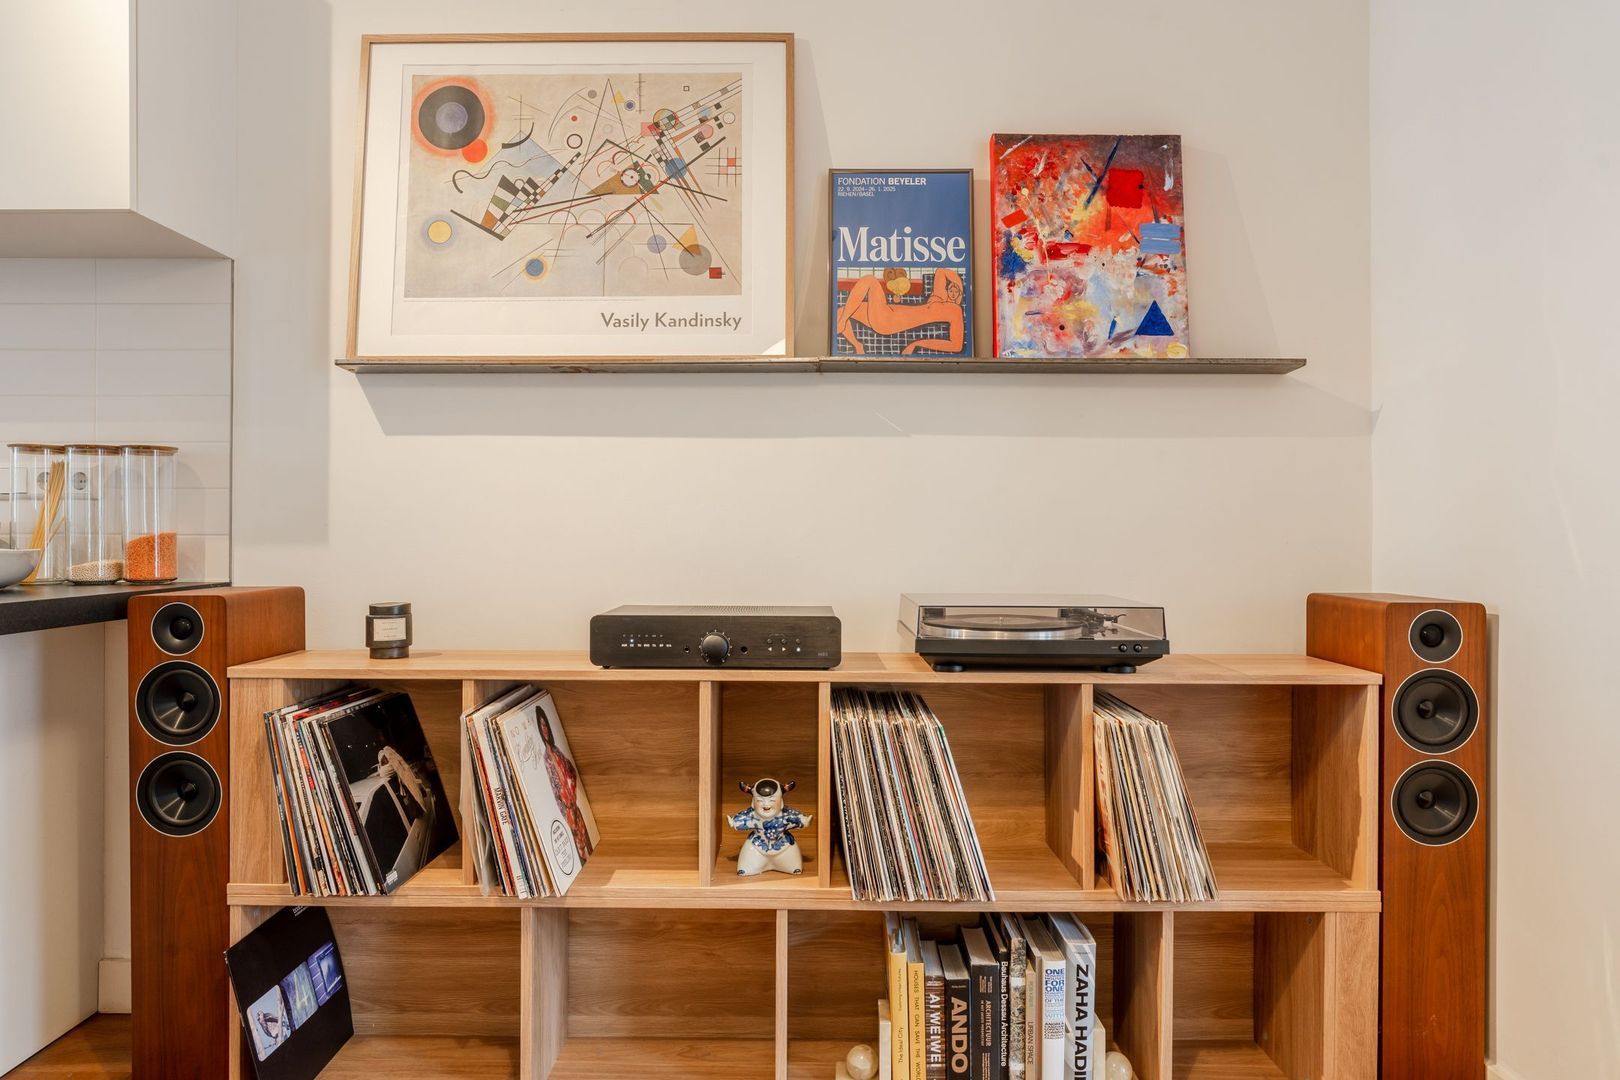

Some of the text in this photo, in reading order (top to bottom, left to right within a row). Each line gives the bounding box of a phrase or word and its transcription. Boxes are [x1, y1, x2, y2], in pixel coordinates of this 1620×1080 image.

[837, 177, 927, 186] FONDATION BEYELER
[838, 226, 966, 263] Matisse
[601, 311, 742, 332] Vasily Kandinsky
[929, 993, 941, 1008] AI
[1000, 961, 1008, 1067] Bauhaus Dessau Architecture
[1075, 964, 1089, 1022] ZAHA
[929, 1012, 942, 1068] WEIWEI
[951, 996, 968, 1074] ANDO
